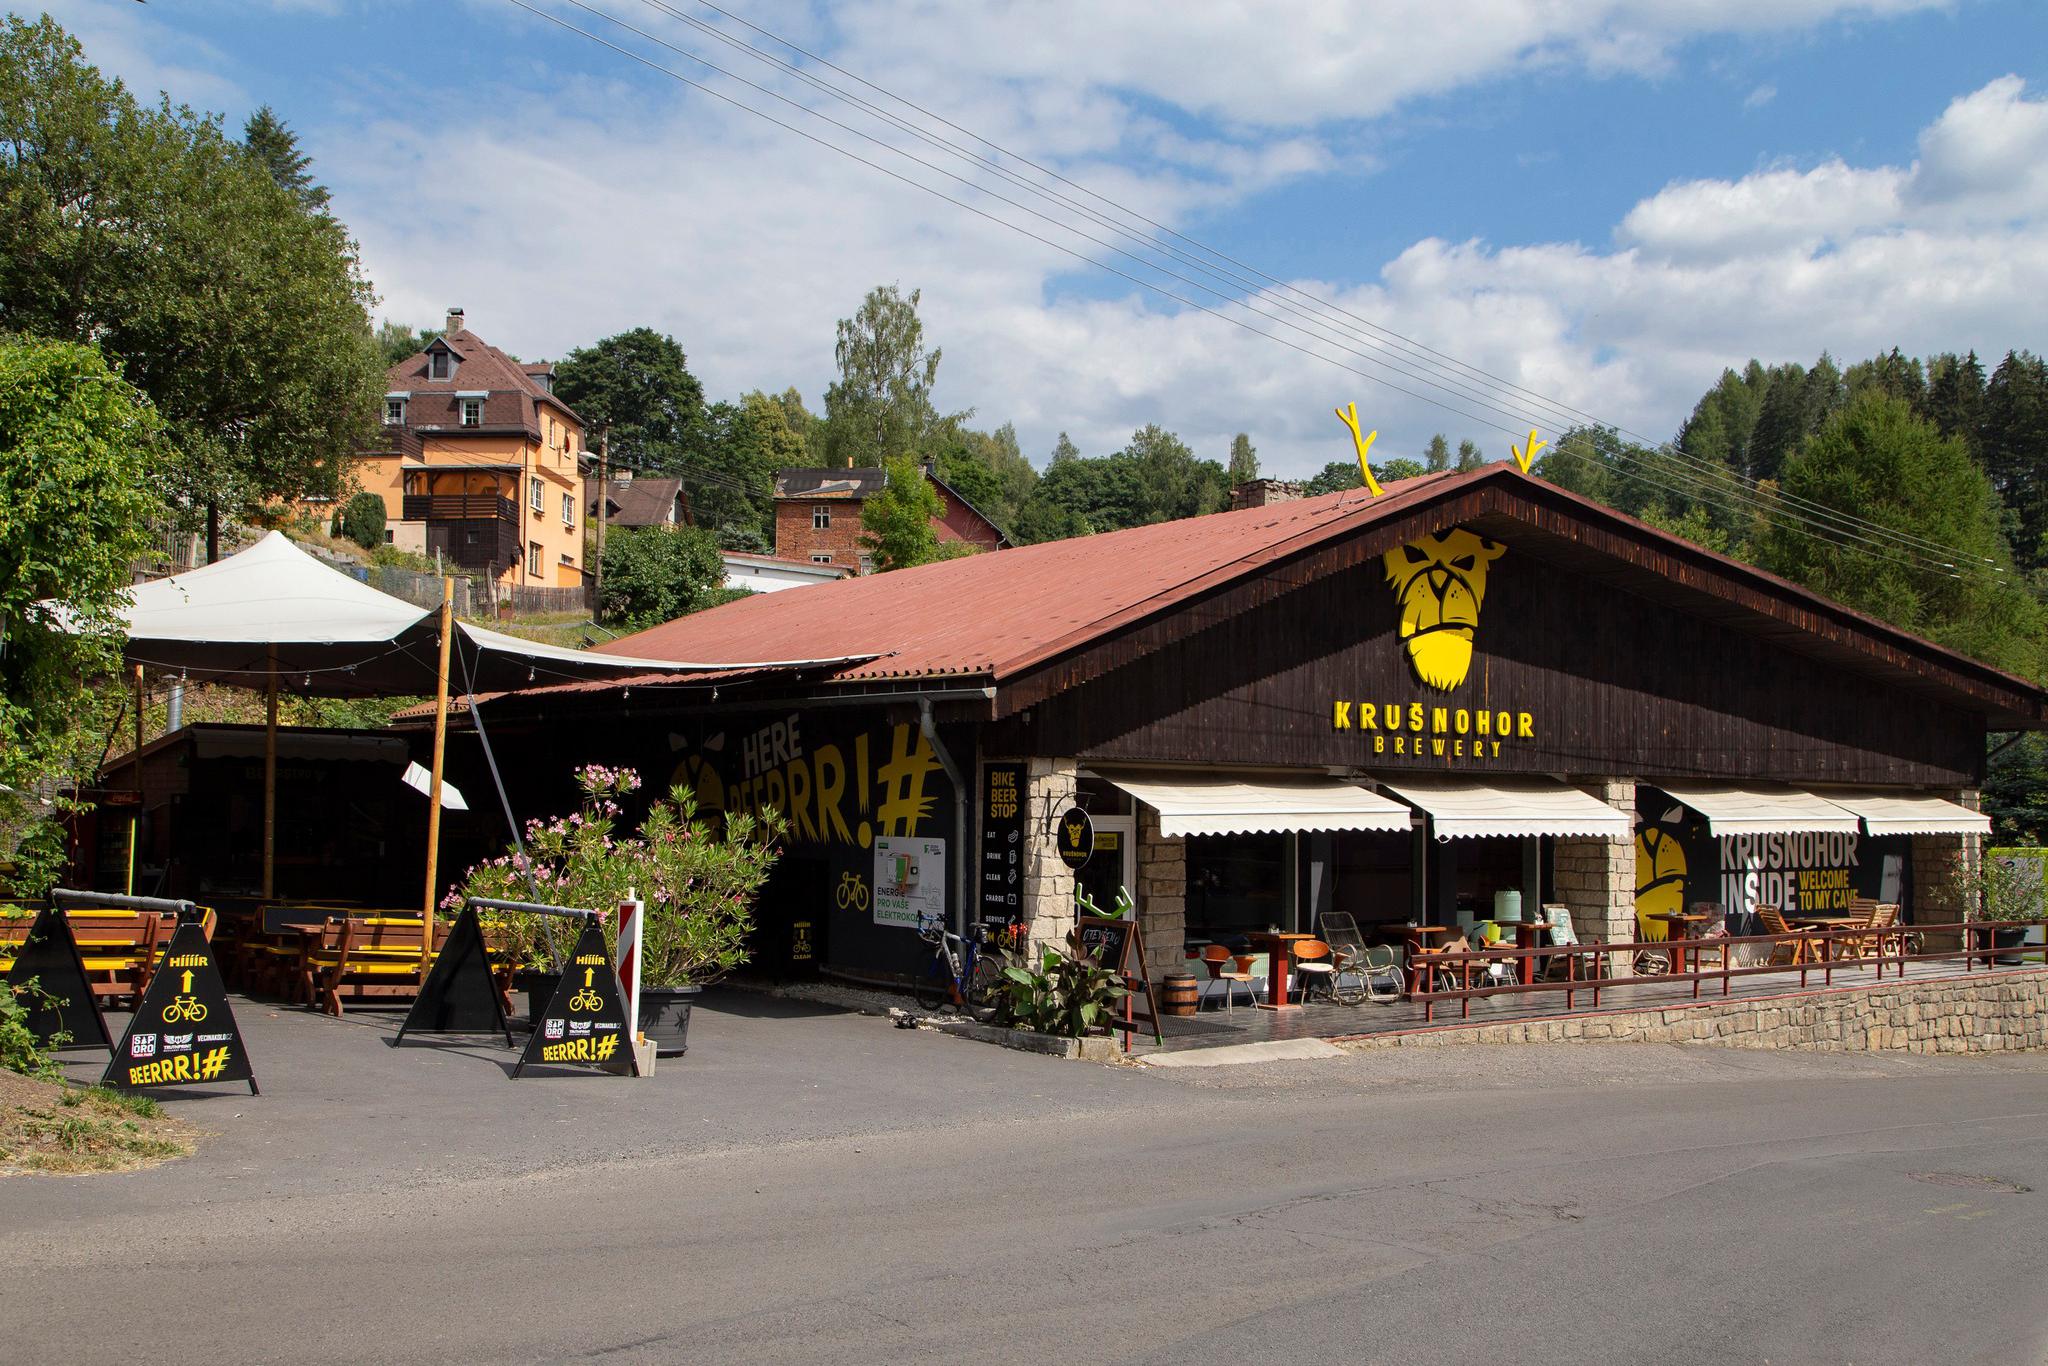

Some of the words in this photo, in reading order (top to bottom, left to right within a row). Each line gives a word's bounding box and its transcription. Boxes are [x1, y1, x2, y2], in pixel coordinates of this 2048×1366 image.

[1333, 701, 1534, 738] KRUŠNOHOR
[742, 712, 803, 778] HERE
[1374, 736, 1501, 758] BREWERY
[991, 771, 1016, 787] BIKE
[991, 788, 1018, 803] BEER
[991, 803, 1018, 818] STOP
[986, 852, 1001, 860] DRINK
[986, 873, 1001, 881] CLEAN
[1799, 870, 1849, 890] WELCOME
[877, 887, 905, 898] ENERGE
[985, 894, 1005, 903] CHARGE
[1721, 871, 1796, 914] INSIDE
[877, 898, 890, 908] PRO
[892, 899, 909, 909] VAŠE
[1799, 892, 1813, 911] TO
[1814, 890, 1831, 910] MY
[877, 910, 923, 922] ELEKTROKOL
[985, 915, 1006, 924] SERVICE
[543, 1034, 619, 1061] BEERRR!#
[129, 1046, 232, 1085] BEERRR!#
